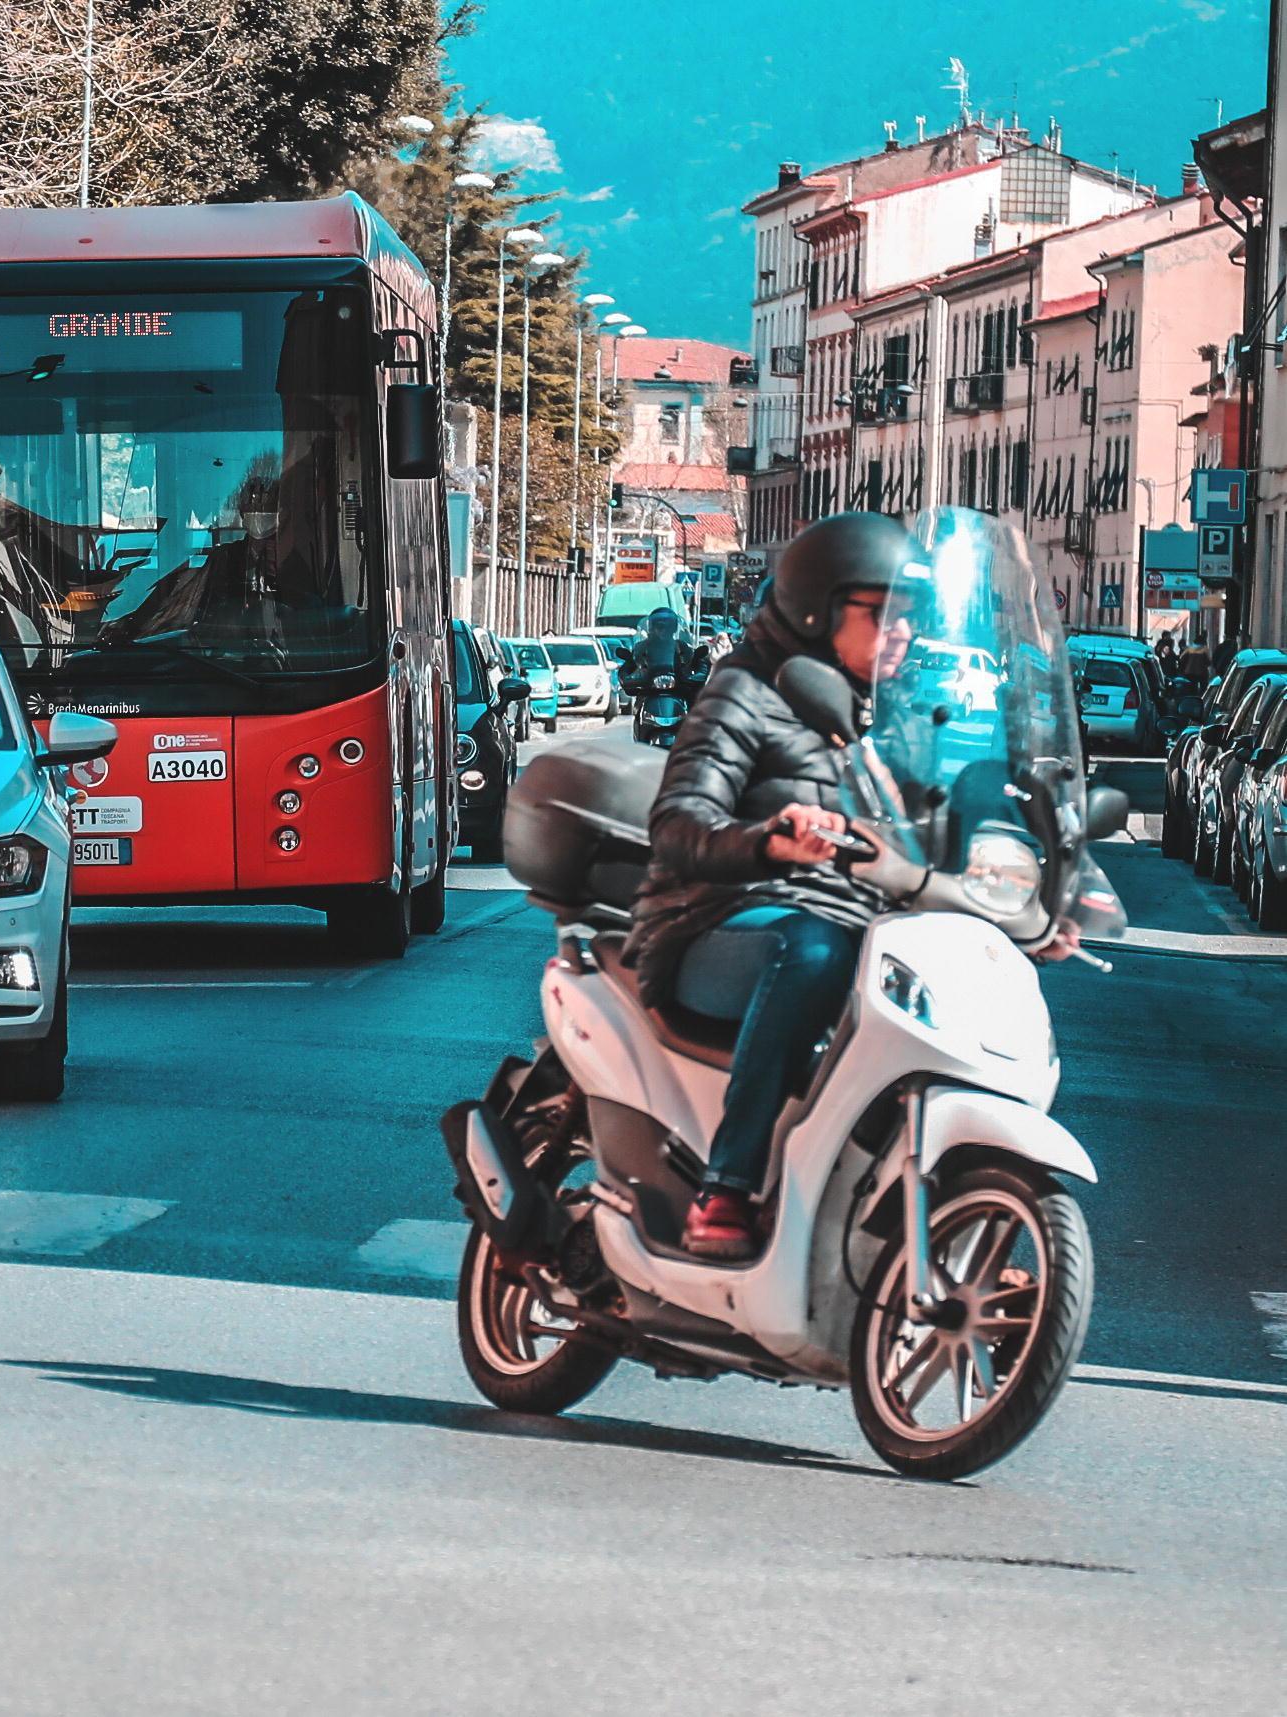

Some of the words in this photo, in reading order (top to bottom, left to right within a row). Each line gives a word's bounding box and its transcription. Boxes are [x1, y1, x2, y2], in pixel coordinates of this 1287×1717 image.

[49, 311, 173, 338] GRANDE
[1208, 530, 1226, 553] P
[708, 567, 720, 581] P
[48, 701, 141, 715] BredaMenarinibus
[151, 758, 224, 780] A3040
[74, 842, 119, 861] 950TL
